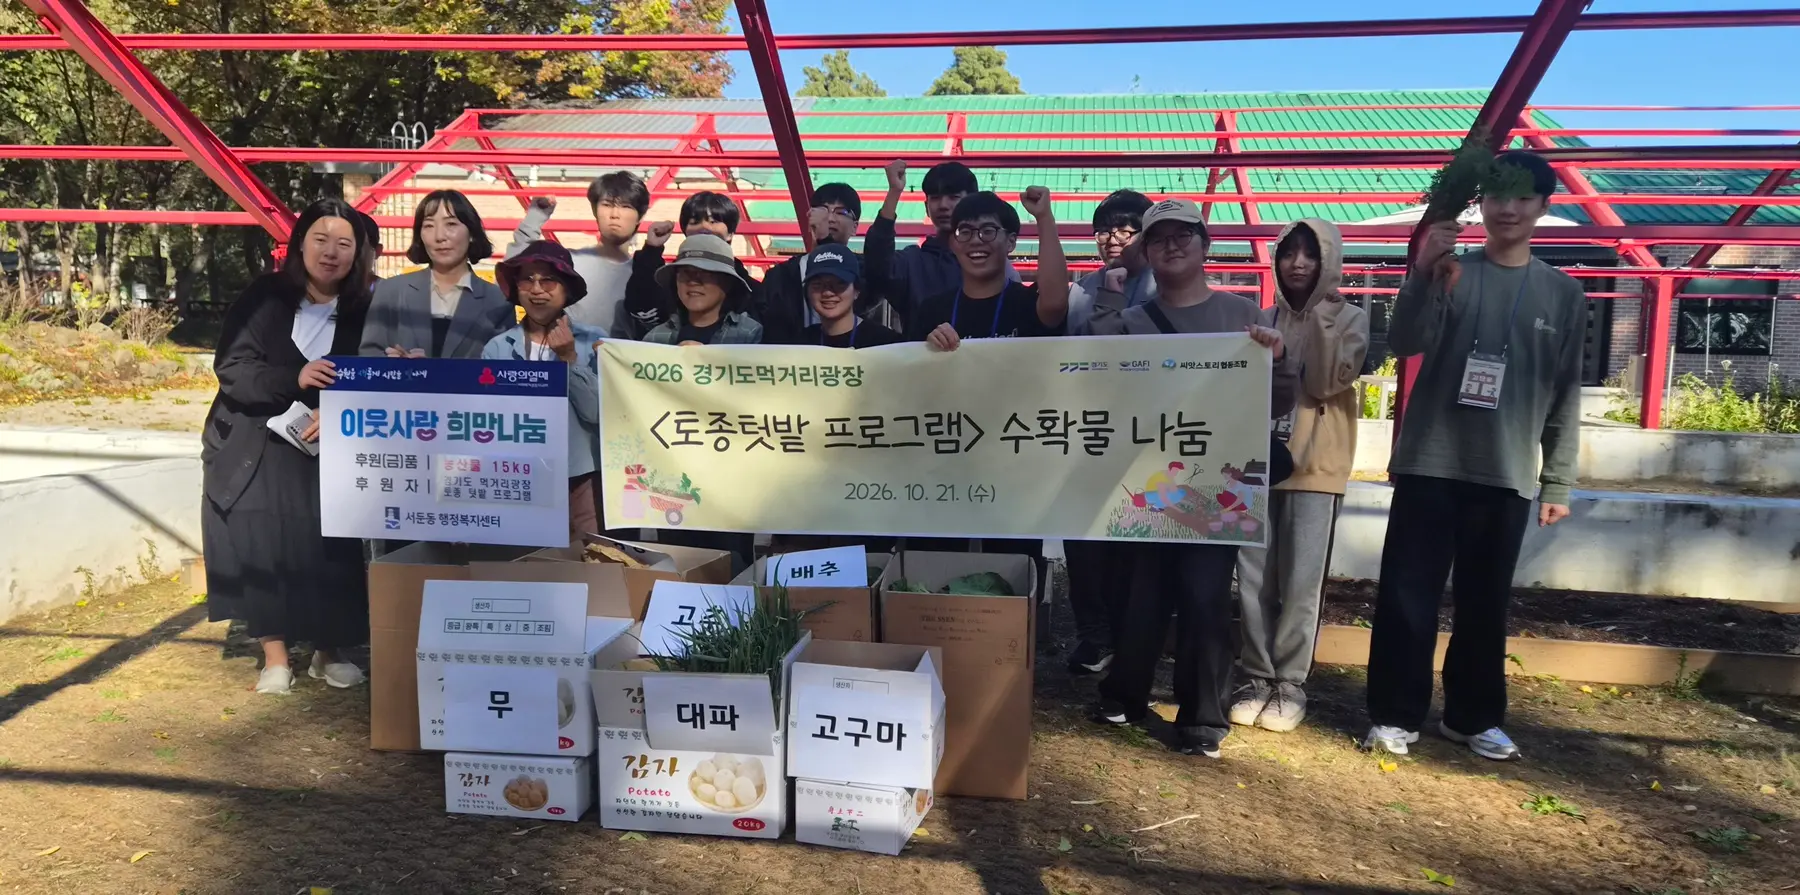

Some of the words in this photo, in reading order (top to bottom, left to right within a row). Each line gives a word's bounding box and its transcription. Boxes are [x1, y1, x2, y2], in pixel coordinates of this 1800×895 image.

[1132, 360, 1150, 368] GAFI
[497, 370, 549, 382] 사랑의열매
[632, 362, 683, 383] 2026
[693, 363, 865, 387] 경기도먹거리광장
[340, 408, 439, 441] 이웃사랑
[447, 410, 546, 444] 희망나눔
[999, 408, 1115, 456] 수확물
[1132, 410, 1213, 456] 나눔
[355, 453, 418, 469] 후원(금)품
[444, 459, 480, 472] 농산물
[493, 460, 530, 475] 15kg
[444, 476, 472, 487] 경기도
[480, 477, 531, 490] 먹거리광장
[444, 487, 461, 499] 토종
[468, 488, 487, 500] 텃밭
[493, 489, 532, 502] 프로그램
[844, 483, 897, 501] 2026.
[904, 483, 929, 501] 10.
[936, 484, 960, 502] 21.
[968, 484, 996, 503] (수)
[406, 511, 436, 526] 서둔동
[438, 513, 500, 528] 행정복지센터
[790, 560, 840, 579] 배추
[504, 623, 512, 632] 상
[522, 623, 530, 632] 중
[487, 690, 513, 719] 무
[676, 703, 740, 731] 대파
[811, 713, 907, 751] 고구마
[622, 754, 680, 779] 감자
[457, 773, 490, 787] 감자
[628, 787, 671, 797] Potato
[737, 819, 761, 830] 20kg
